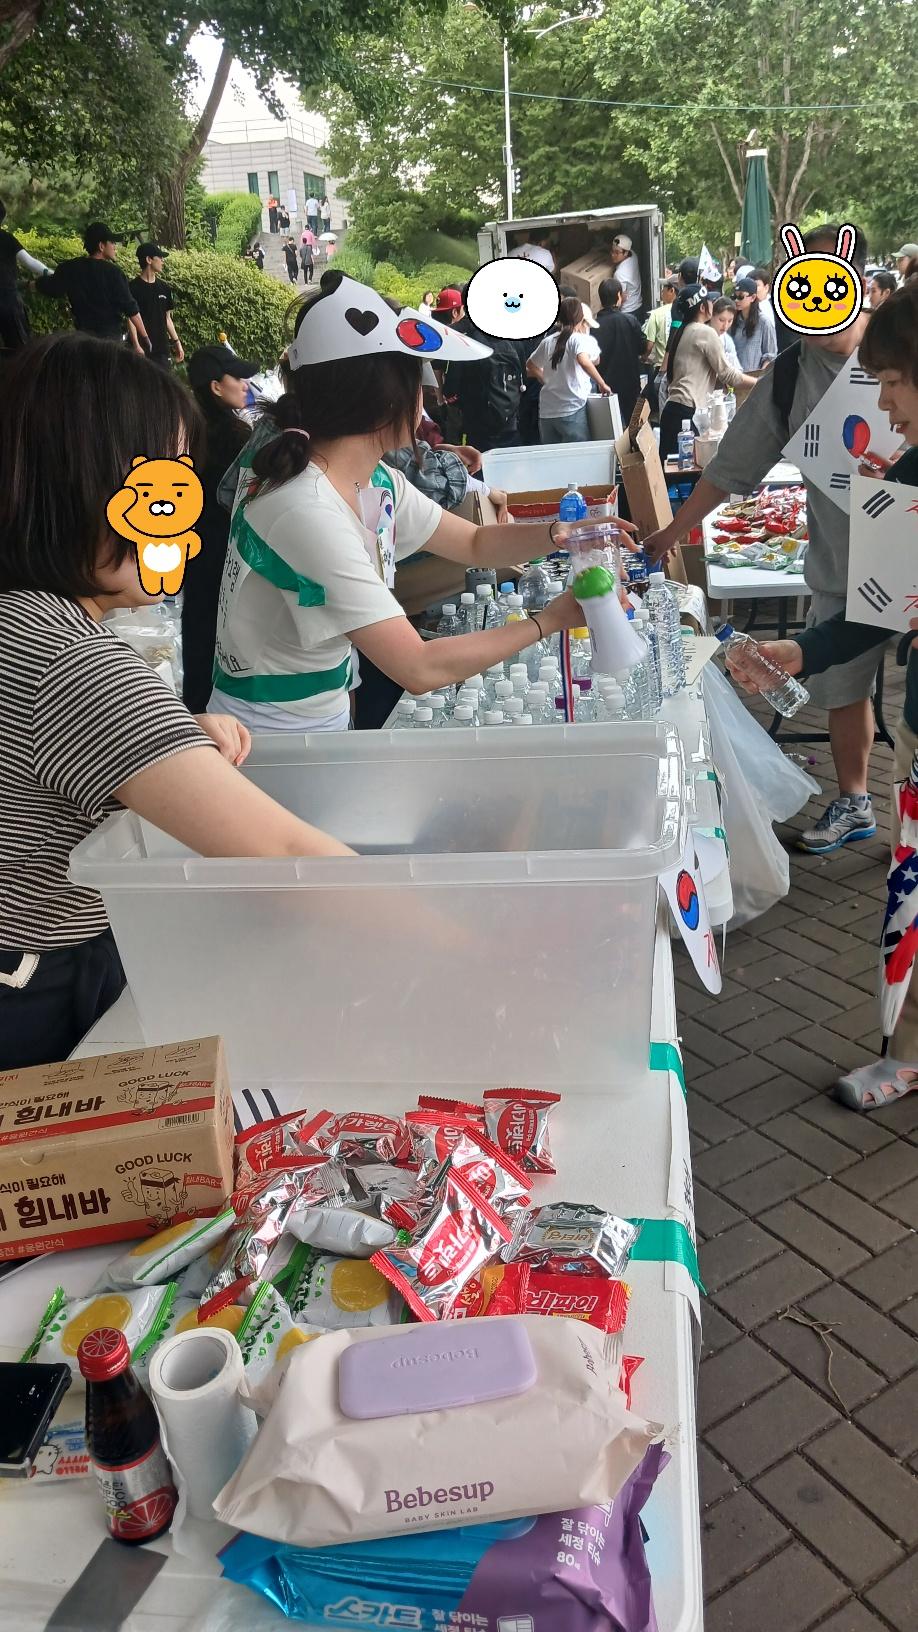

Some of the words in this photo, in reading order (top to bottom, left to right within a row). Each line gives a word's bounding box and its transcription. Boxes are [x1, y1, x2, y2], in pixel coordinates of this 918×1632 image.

[118, 1074, 156, 1088] GOOD
[158, 1070, 191, 1079] LUCK
[13, 1095, 105, 1125] 힘내바
[115, 1155, 154, 1175] GOOD
[156, 1152, 193, 1163] LUCK
[26, 1173, 66, 1190] 필요해
[14, 1187, 111, 1228] 힘내바
[55, 1465, 89, 1475] HELLO
[384, 1480, 495, 1513] Bebesup
[405, 1514, 430, 1523] BABY
[434, 1510, 457, 1519] SKIN
[560, 1517, 575, 1531] 잘
[577, 1521, 606, 1550] 닦이는
[558, 1533, 585, 1551] 세정
[587, 1542, 601, 1567] 티슈
[324, 1595, 423, 1630] 스카트
[431, 1608, 446, 1621] 잘
[449, 1611, 489, 1626] 닦이는
